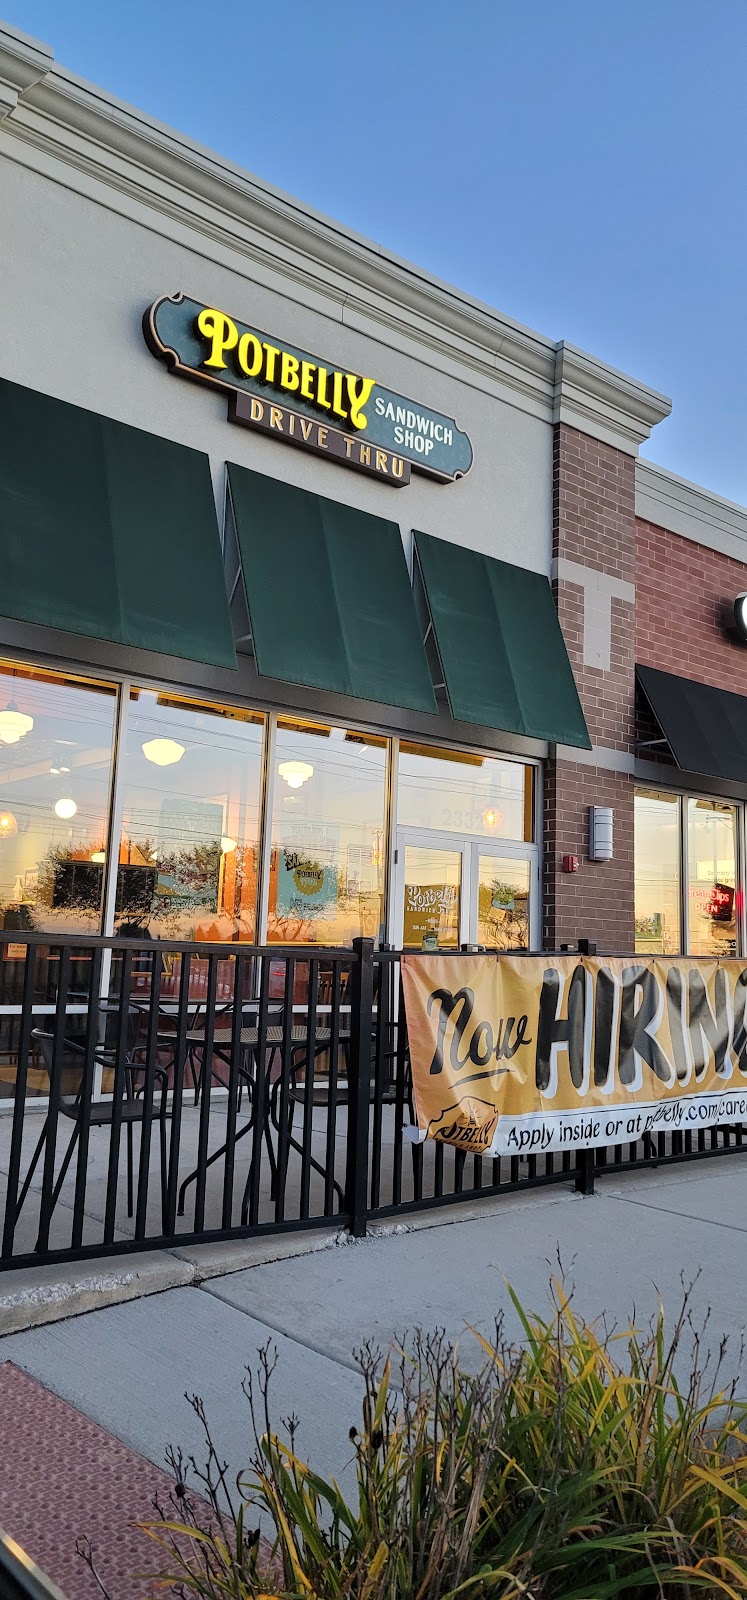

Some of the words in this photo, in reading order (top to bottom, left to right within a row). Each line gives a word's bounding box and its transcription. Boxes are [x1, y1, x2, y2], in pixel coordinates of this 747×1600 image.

[198, 309, 376, 430] POTBELLY
[250, 398, 328, 449] DRIVE
[343, 437, 404, 478] THRU
[375, 397, 453, 446] SANDWICH
[394, 427, 434, 456] SHOP
[406, 905, 436, 914] SANDWICH
[694, 902, 718, 912] OPEN
[710, 888, 730, 904] Clips
[427, 986, 532, 1075] Now
[507, 1123, 555, 1150] Apply
[559, 1117, 601, 1143] inside
[605, 1118, 623, 1137] or
[626, 1114, 642, 1133] at
